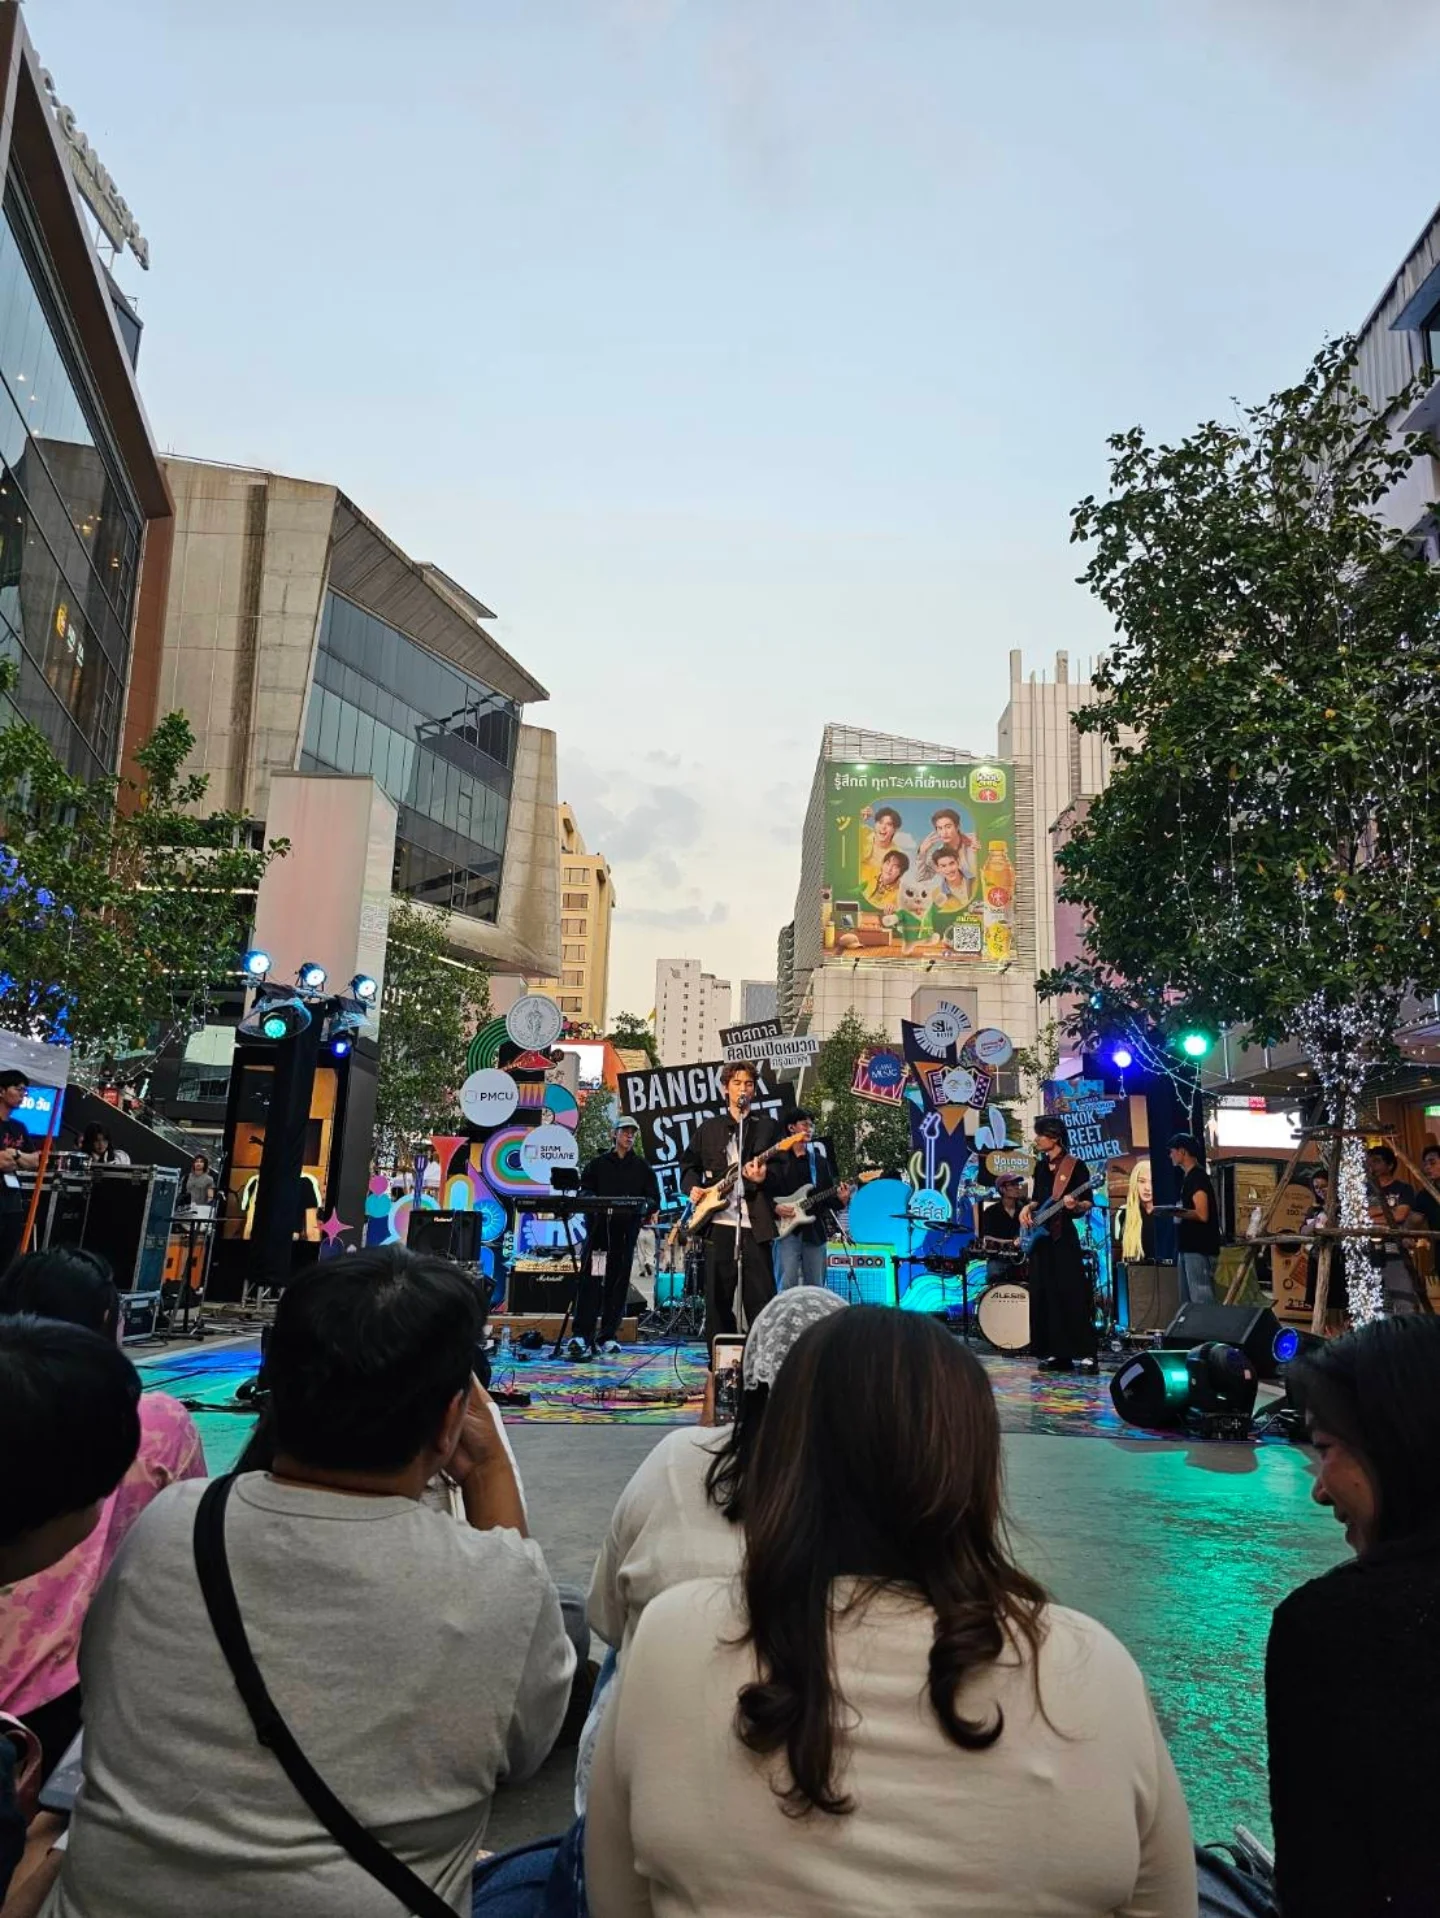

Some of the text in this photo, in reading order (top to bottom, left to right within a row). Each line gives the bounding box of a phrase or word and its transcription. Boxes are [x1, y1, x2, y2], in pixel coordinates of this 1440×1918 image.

[834, 772, 867, 790] รู้สึกดี
[726, 1024, 778, 1044] เทศกาล
[727, 1039, 817, 1061] ศิลปินเปิดหมวก
[480, 1092, 514, 1101] PMCU
[627, 1060, 770, 1113] BANGKK
[1067, 1124, 1102, 1146] REET
[540, 1152, 575, 1160] SQUARE
[1069, 1140, 1122, 1161] FORMER
